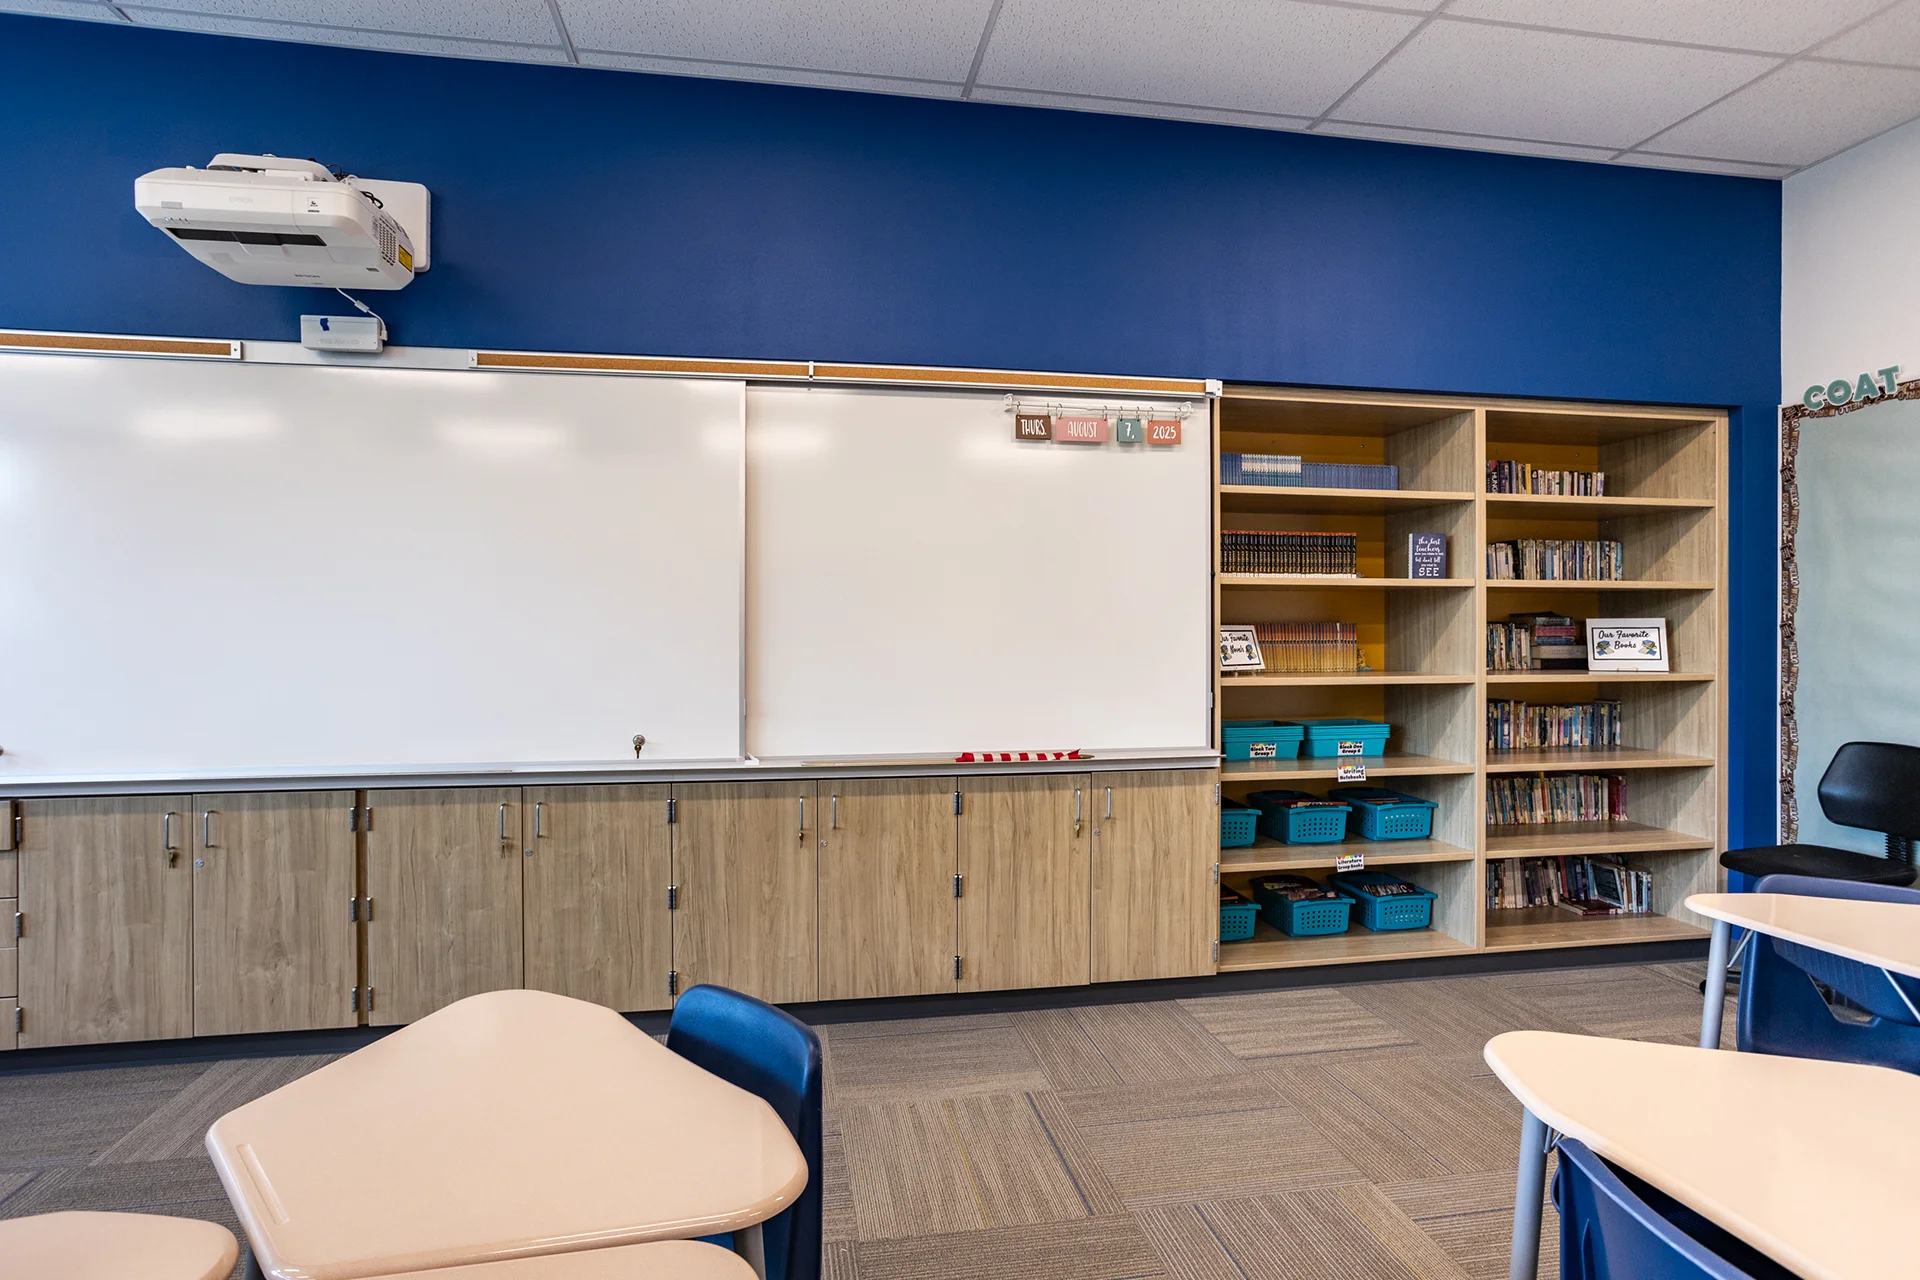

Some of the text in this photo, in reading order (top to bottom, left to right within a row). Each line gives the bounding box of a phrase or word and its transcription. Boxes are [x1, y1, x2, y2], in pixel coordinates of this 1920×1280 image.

[1803, 364, 1900, 410] COAT
[1020, 420, 1176, 439] THURS. AUGUST 7, 2025
[1418, 536, 1428, 544] the
[1419, 568, 1439, 576] SEE
[1229, 633, 1249, 643] Favorite
[1598, 630, 1650, 639] Our Favorite
[1614, 641, 1637, 649] Books
